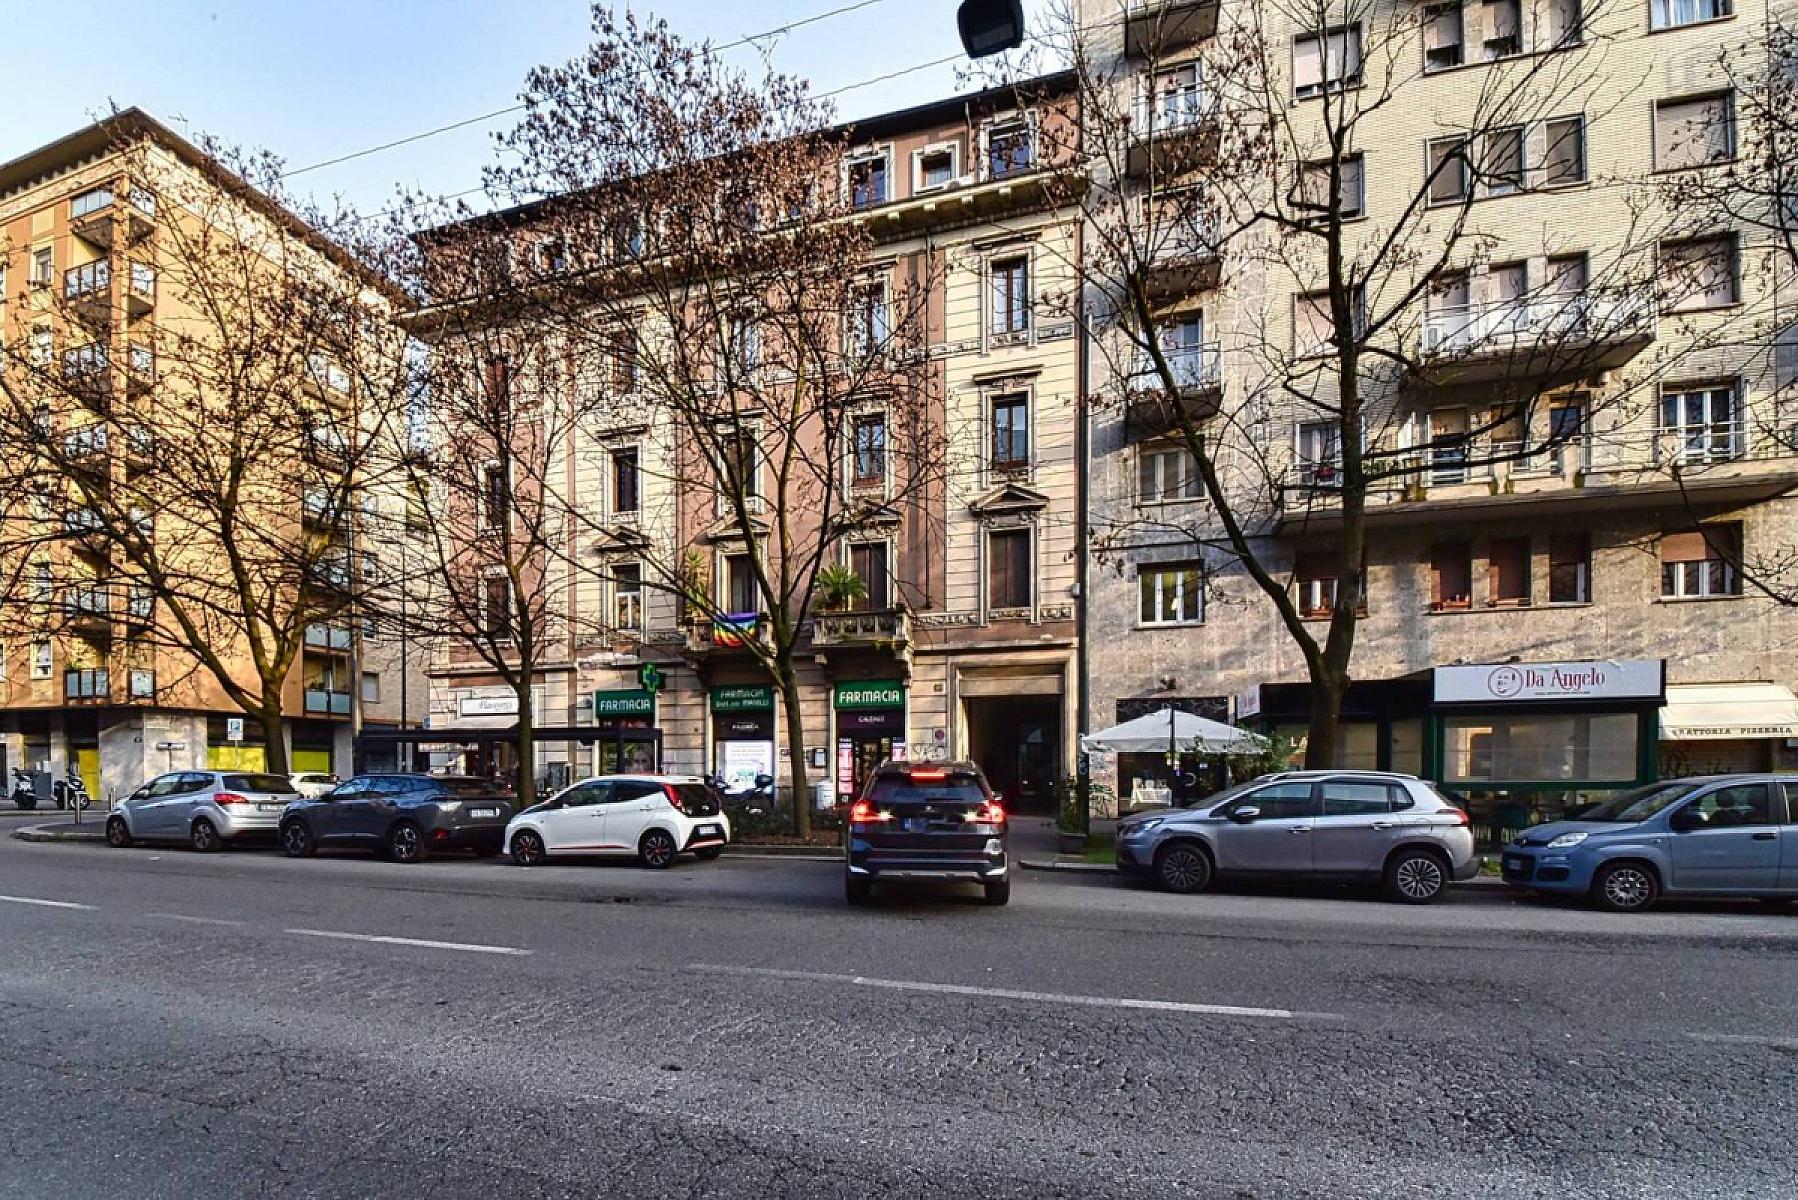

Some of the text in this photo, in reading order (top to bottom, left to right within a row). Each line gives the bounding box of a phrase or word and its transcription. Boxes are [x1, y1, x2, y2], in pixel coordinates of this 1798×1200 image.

[1526, 667, 1606, 690] Da Angelo
[839, 690, 900, 704] FARMACIA
[600, 699, 651, 711] FARMACIA
[1740, 727, 1793, 735] PIZZERIA
